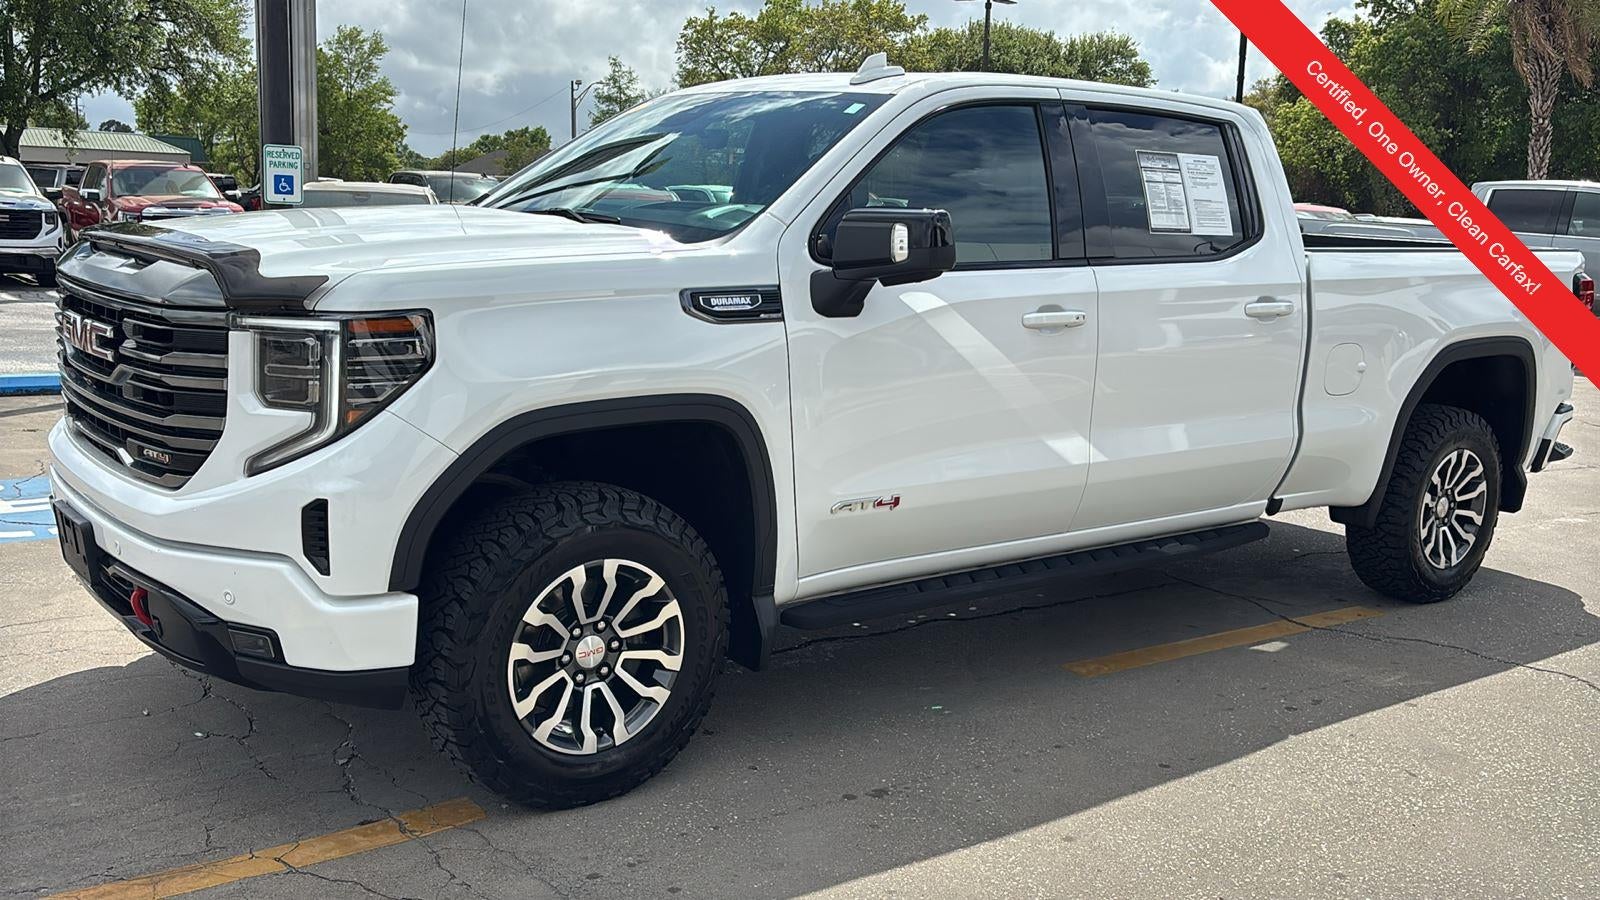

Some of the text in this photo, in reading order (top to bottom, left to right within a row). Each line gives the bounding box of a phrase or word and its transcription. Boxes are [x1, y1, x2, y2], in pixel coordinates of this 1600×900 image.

[266, 150, 300, 160] RESERVED
[268, 160, 299, 170] PARKING
[710, 297, 752, 306] DURAMAX
[61, 309, 114, 362] GMC
[143, 449, 170, 465] AT4
[829, 494, 901, 515] AT4
[577, 646, 604, 659] GMC
